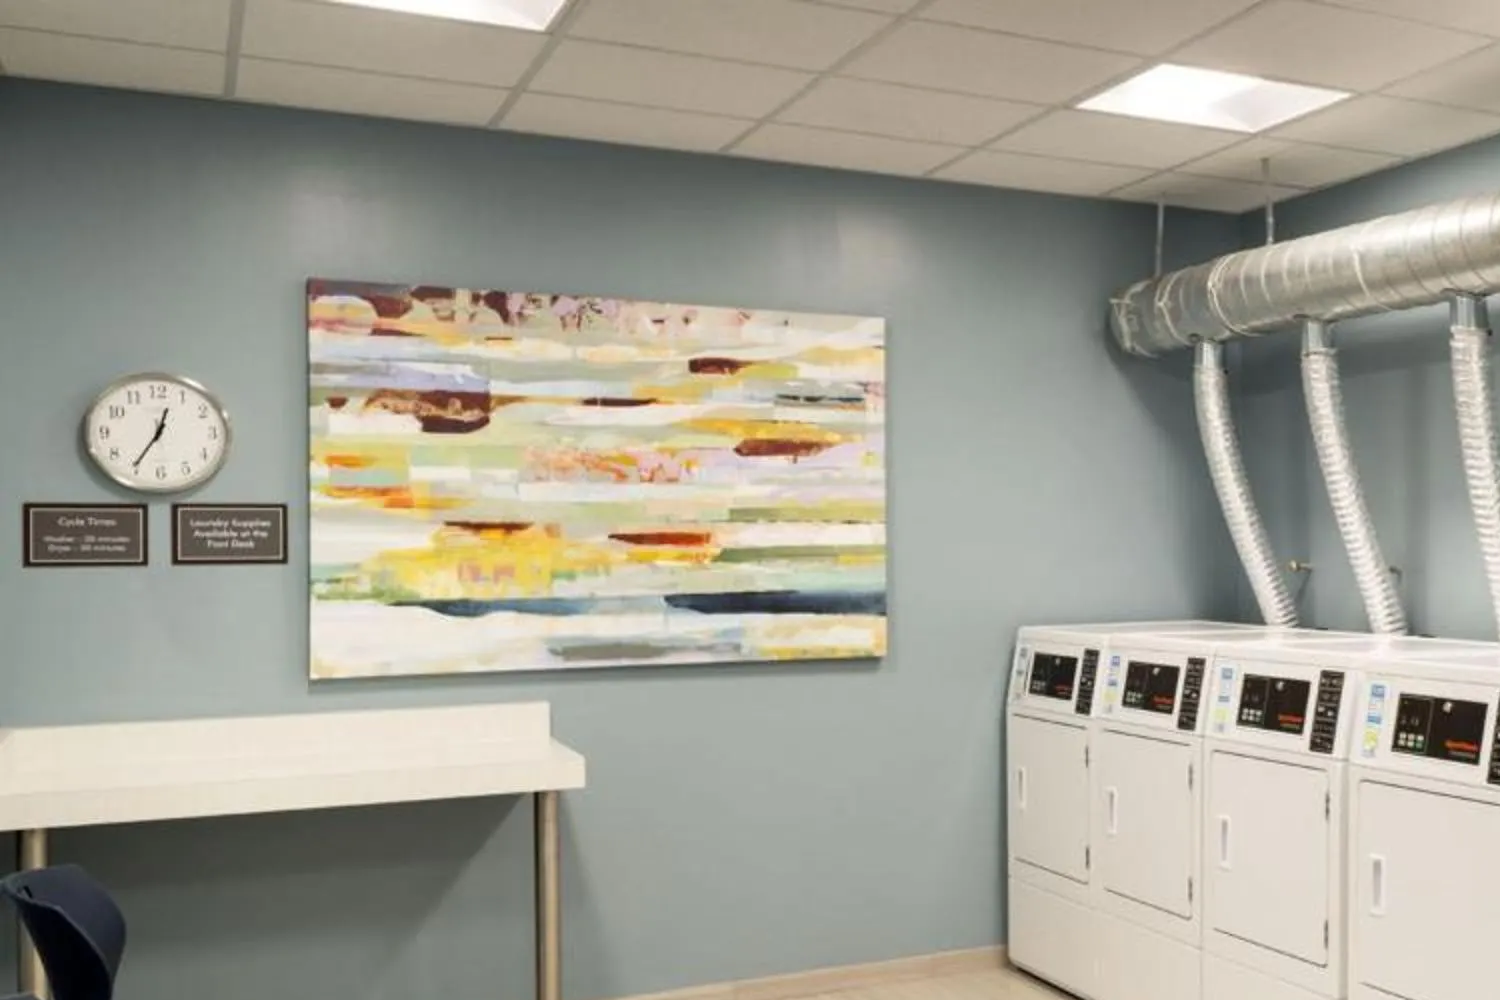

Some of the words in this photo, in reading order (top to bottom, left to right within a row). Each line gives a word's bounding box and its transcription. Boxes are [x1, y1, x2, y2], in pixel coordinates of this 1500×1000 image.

[127, 390, 140, 404] 11
[149, 385, 167, 399] 12
[109, 405, 125, 419] 10
[99, 426, 110, 440] 9
